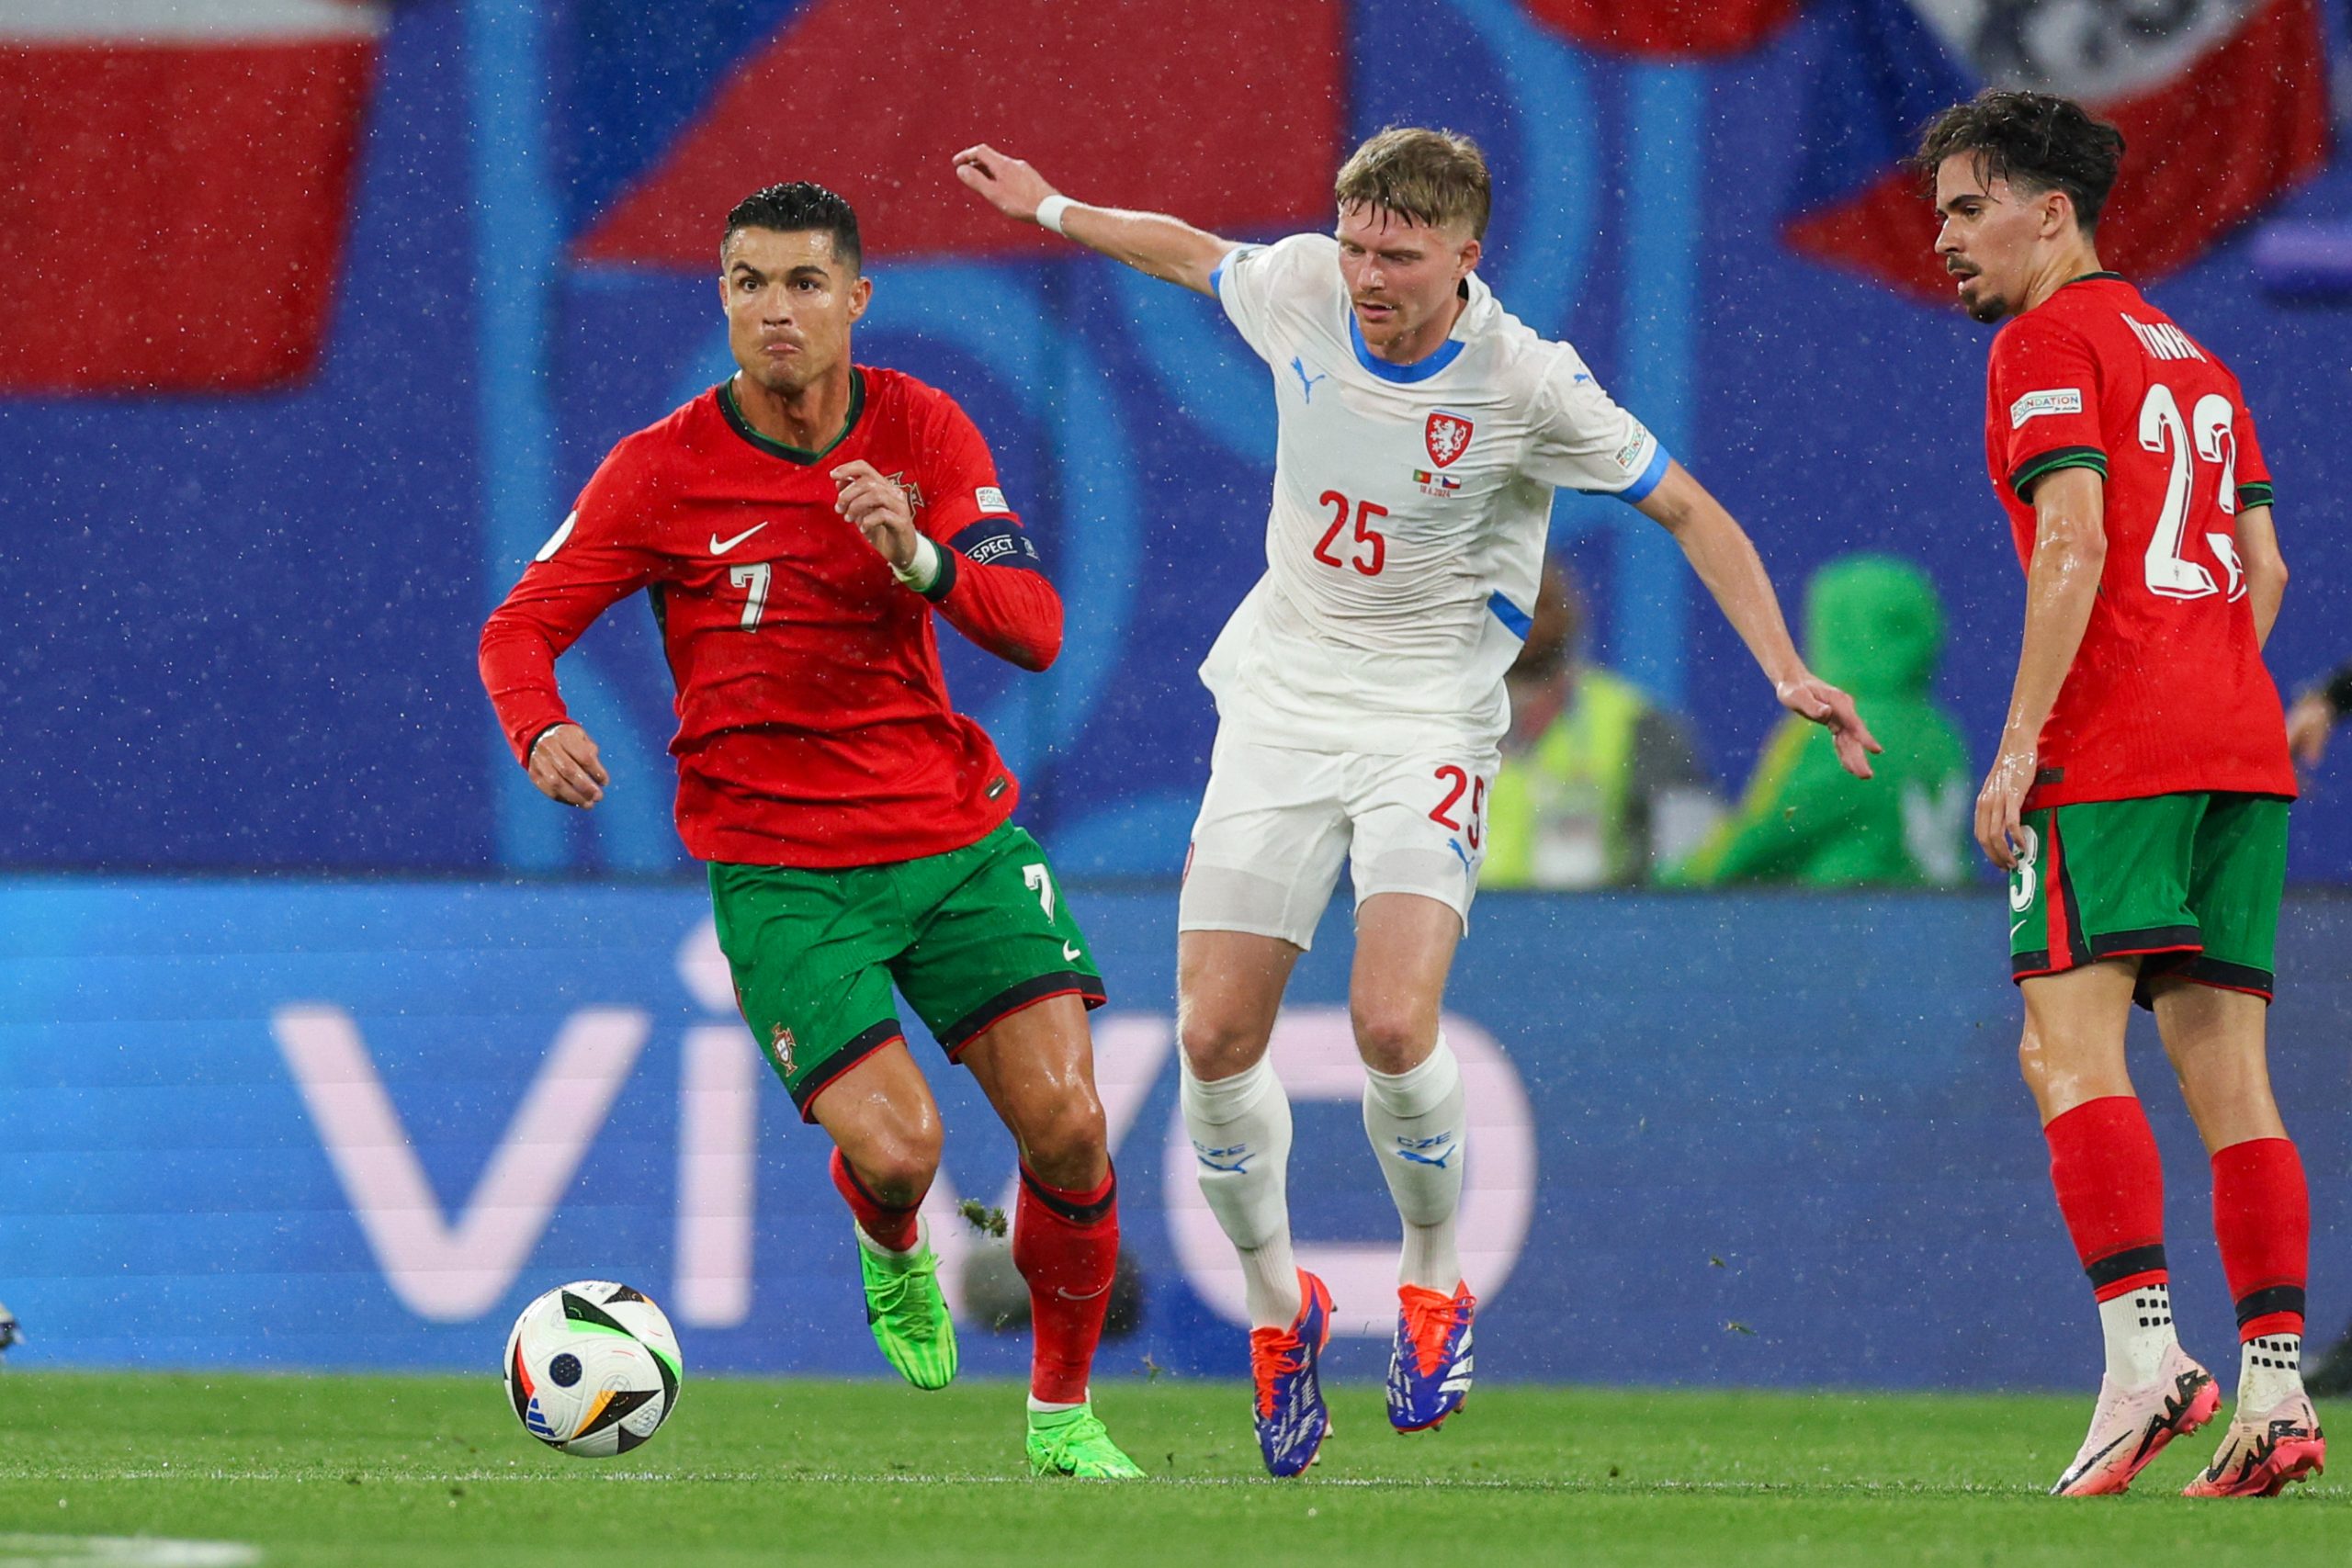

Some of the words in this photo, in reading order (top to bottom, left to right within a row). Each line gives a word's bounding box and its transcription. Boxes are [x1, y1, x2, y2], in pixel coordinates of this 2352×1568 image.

[2139, 383, 2247, 603] 23
[967, 538, 1013, 563] SPECT
[1314, 490, 1388, 576] 25
[730, 562, 771, 634] 7
[1429, 765, 1485, 851] 25
[1022, 863, 1057, 927] 7
[1396, 1131, 1451, 1148] CZE
